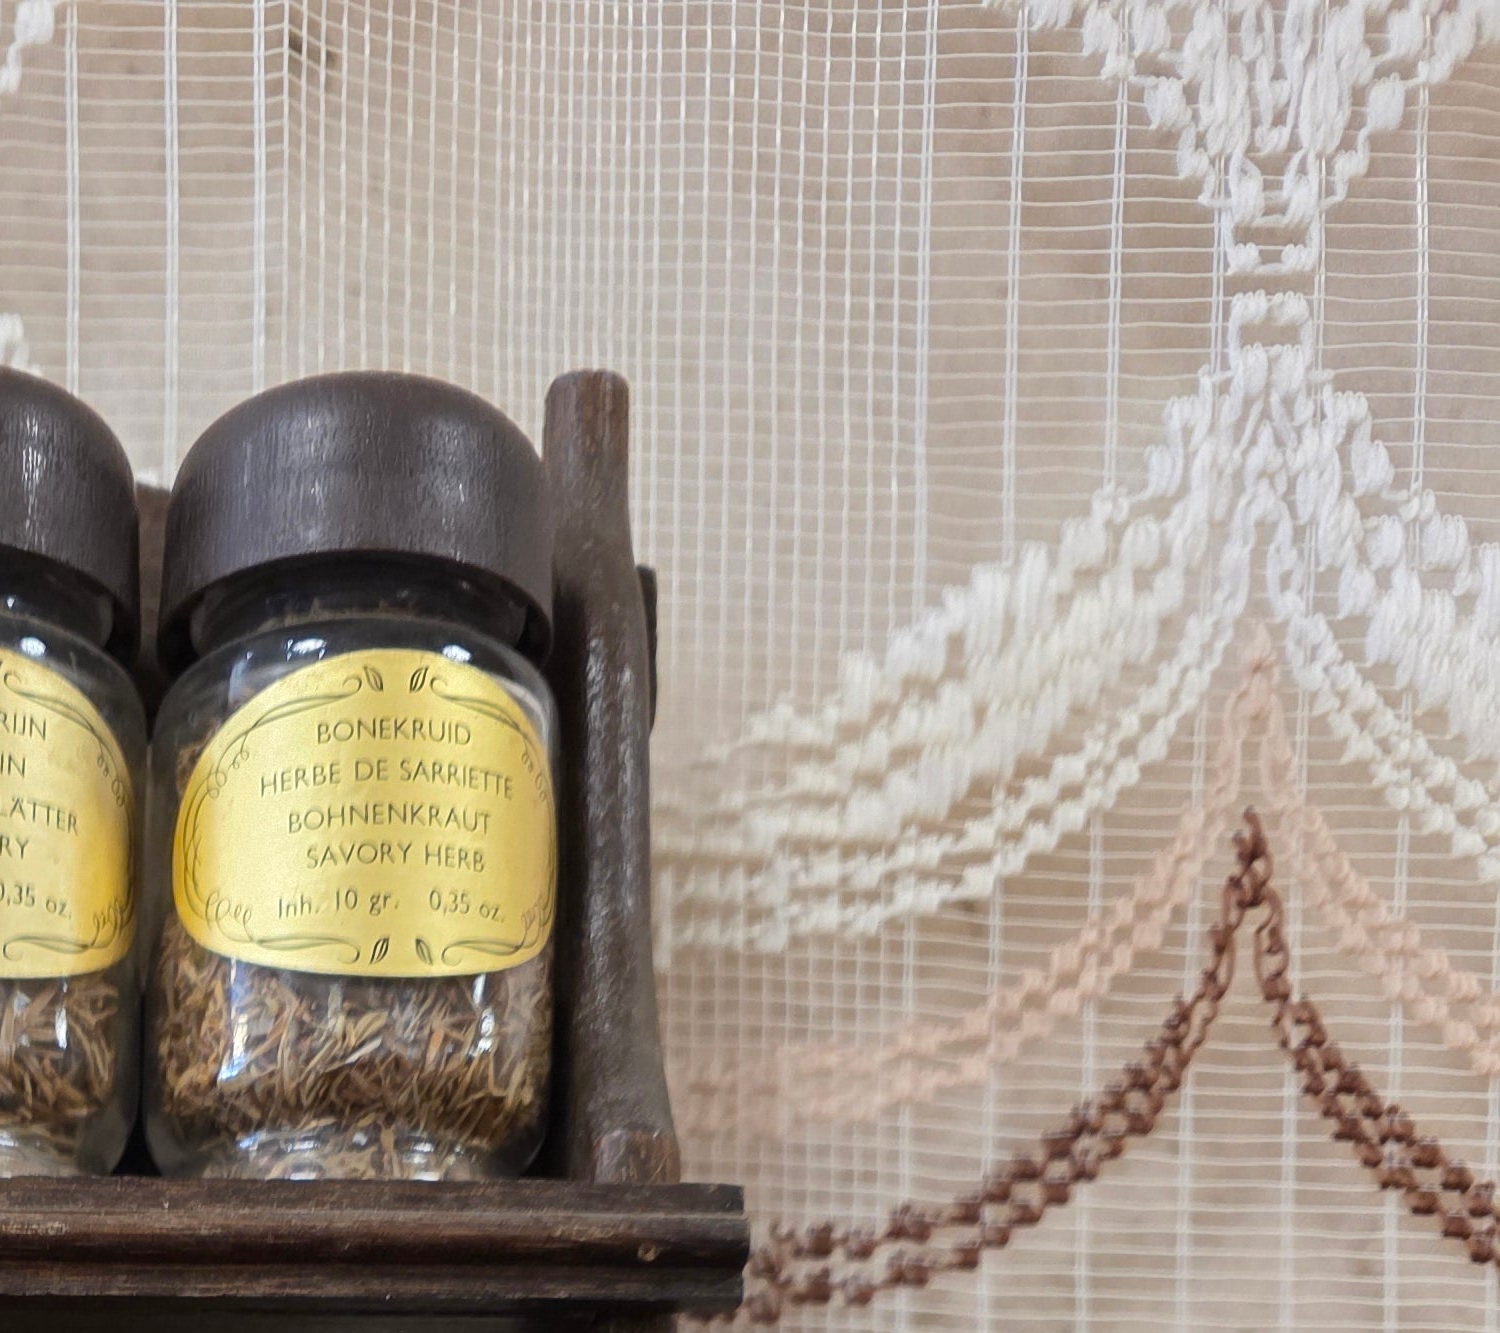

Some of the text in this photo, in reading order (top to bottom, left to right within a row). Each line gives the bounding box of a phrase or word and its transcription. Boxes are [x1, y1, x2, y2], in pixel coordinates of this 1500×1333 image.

[317, 718, 471, 745] BONEKRUID
[260, 757, 513, 799] HERBE DE SARRIETTE
[288, 803, 491, 834] BOHNENKRAUT
[306, 843, 485, 872] SAVORY HERB
[46, 898, 72, 919] oz.
[278, 889, 504, 922] Inh. 10 gr. 0,35 oz.
